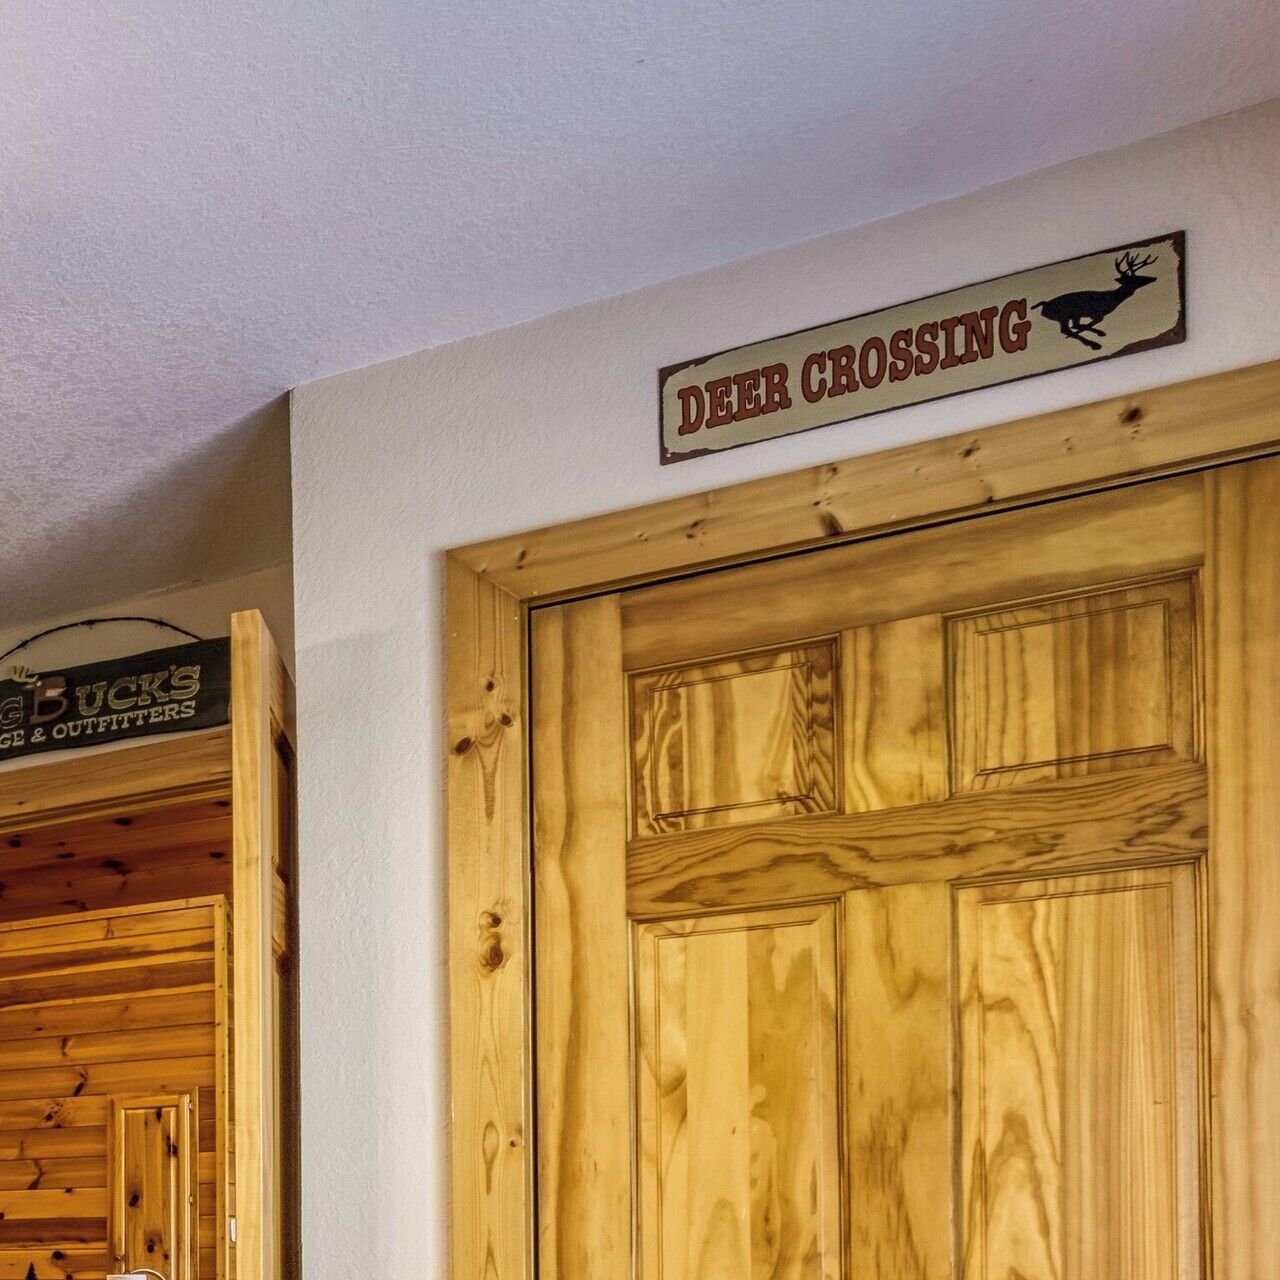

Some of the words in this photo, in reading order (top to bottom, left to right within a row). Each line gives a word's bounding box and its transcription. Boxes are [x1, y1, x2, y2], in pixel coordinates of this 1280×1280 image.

[677, 361, 792, 437] DEER
[801, 298, 1032, 404] CROSSING
[31, 727, 46, 743] &
[52, 700, 196, 740] OUTFITTERS
